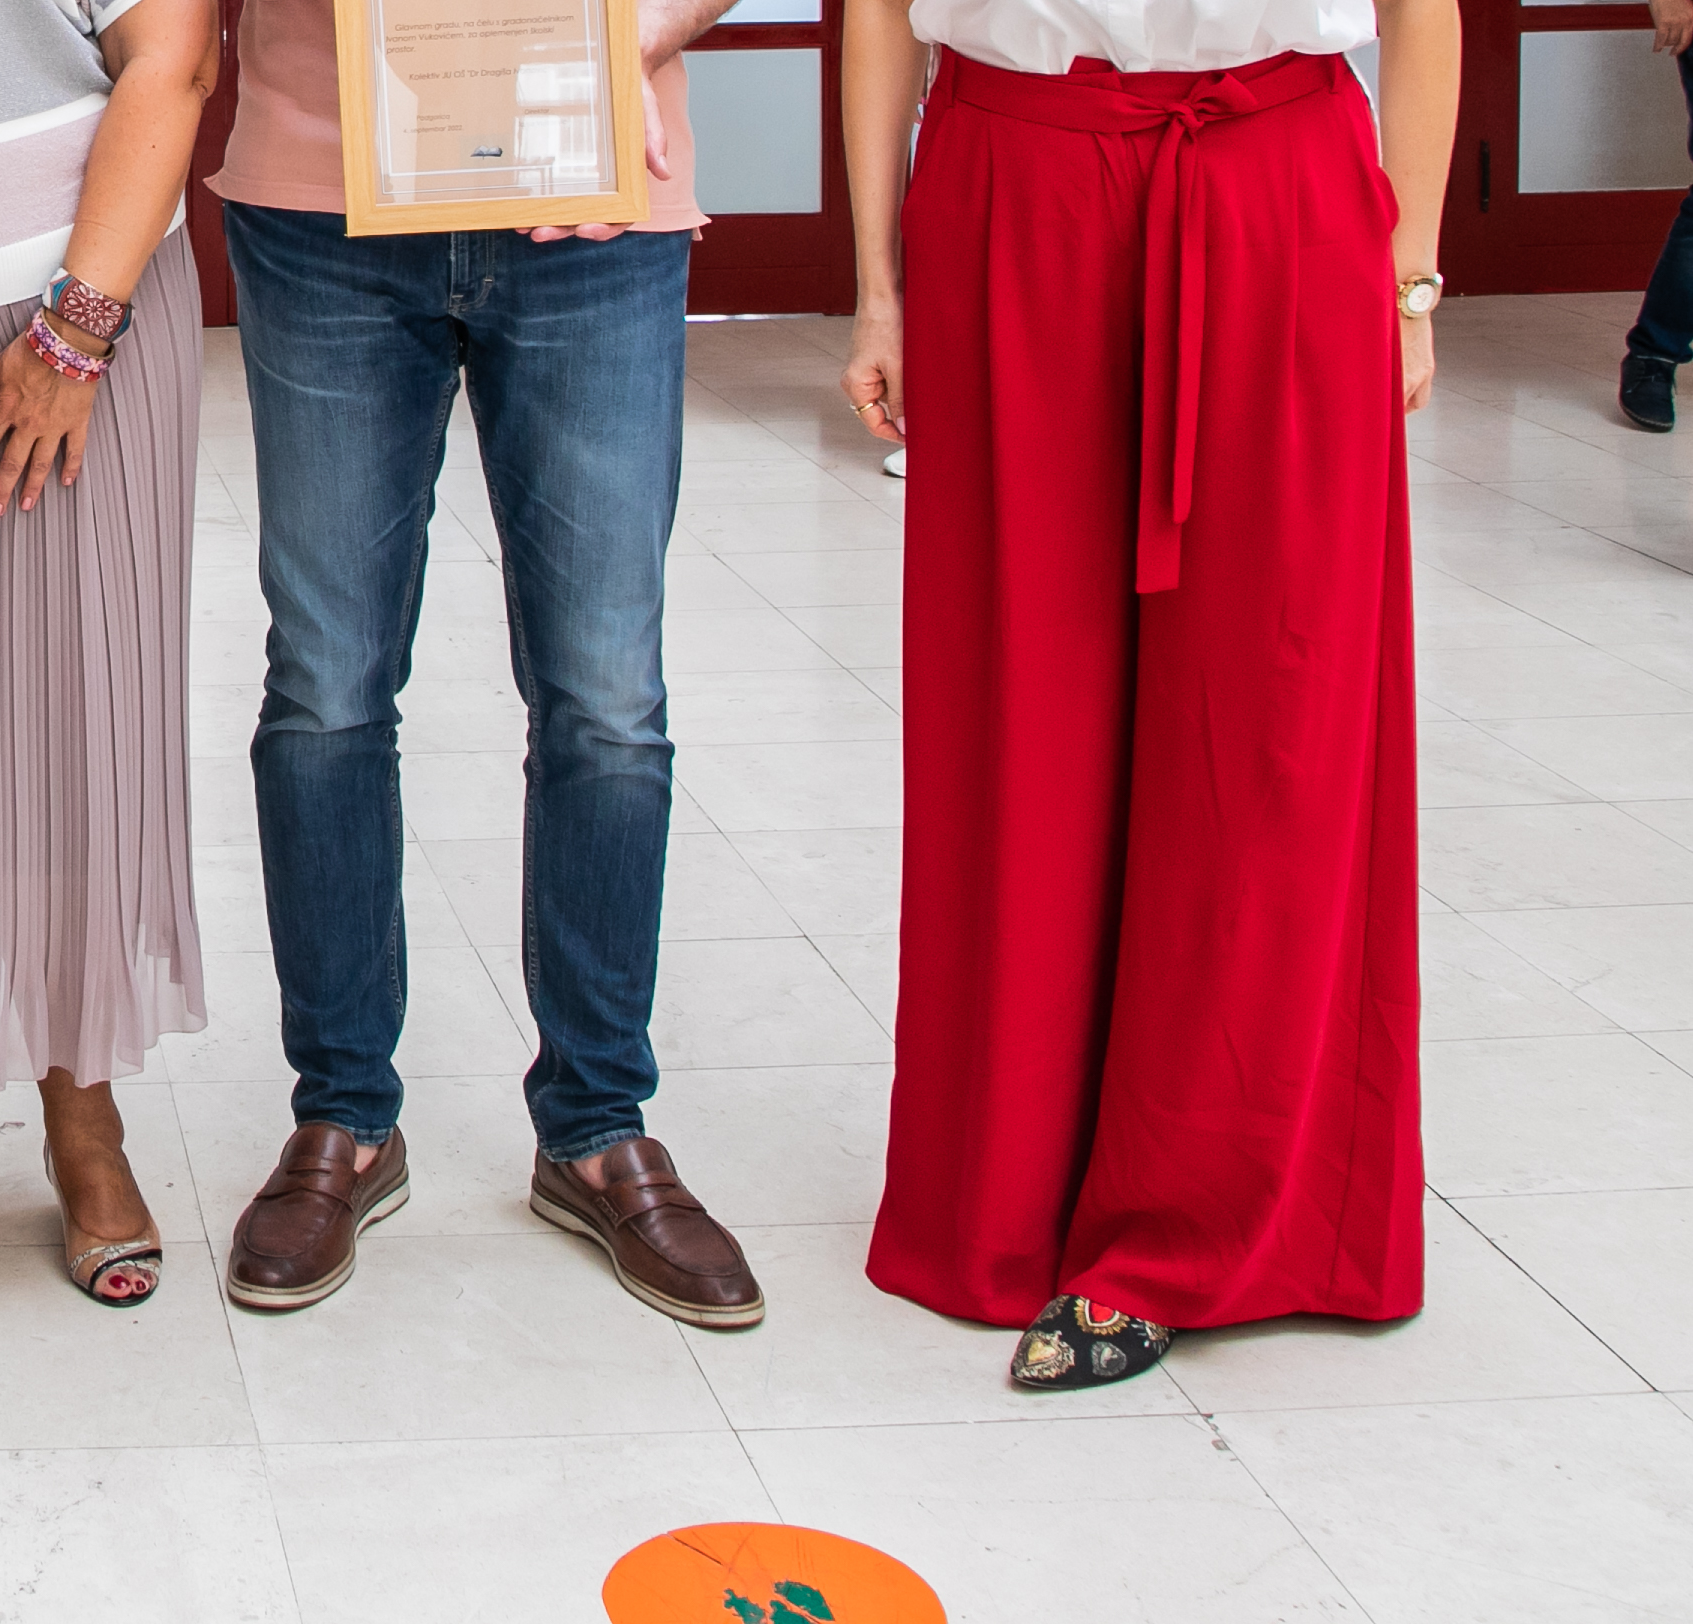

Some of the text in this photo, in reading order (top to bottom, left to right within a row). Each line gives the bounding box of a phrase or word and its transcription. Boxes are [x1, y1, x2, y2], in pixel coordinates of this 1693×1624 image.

[394, 23, 433, 32] Glavnom
[463, 20, 475, 28] na
[476, 18, 495, 27] čelu
[501, 15, 575, 27] gradonačelnikom
[385, 35, 417, 43] Ivanom
[467, 31, 478, 39] za
[479, 28, 528, 38] oplemenjen
[386, 45, 417, 55] prostor.
[408, 72, 440, 81] Kolektiv
[441, 70, 452, 79] JU
[453, 69, 466, 78] OŠ
[480, 67, 512, 78] Dragiša
[416, 113, 451, 122] Podgorica
